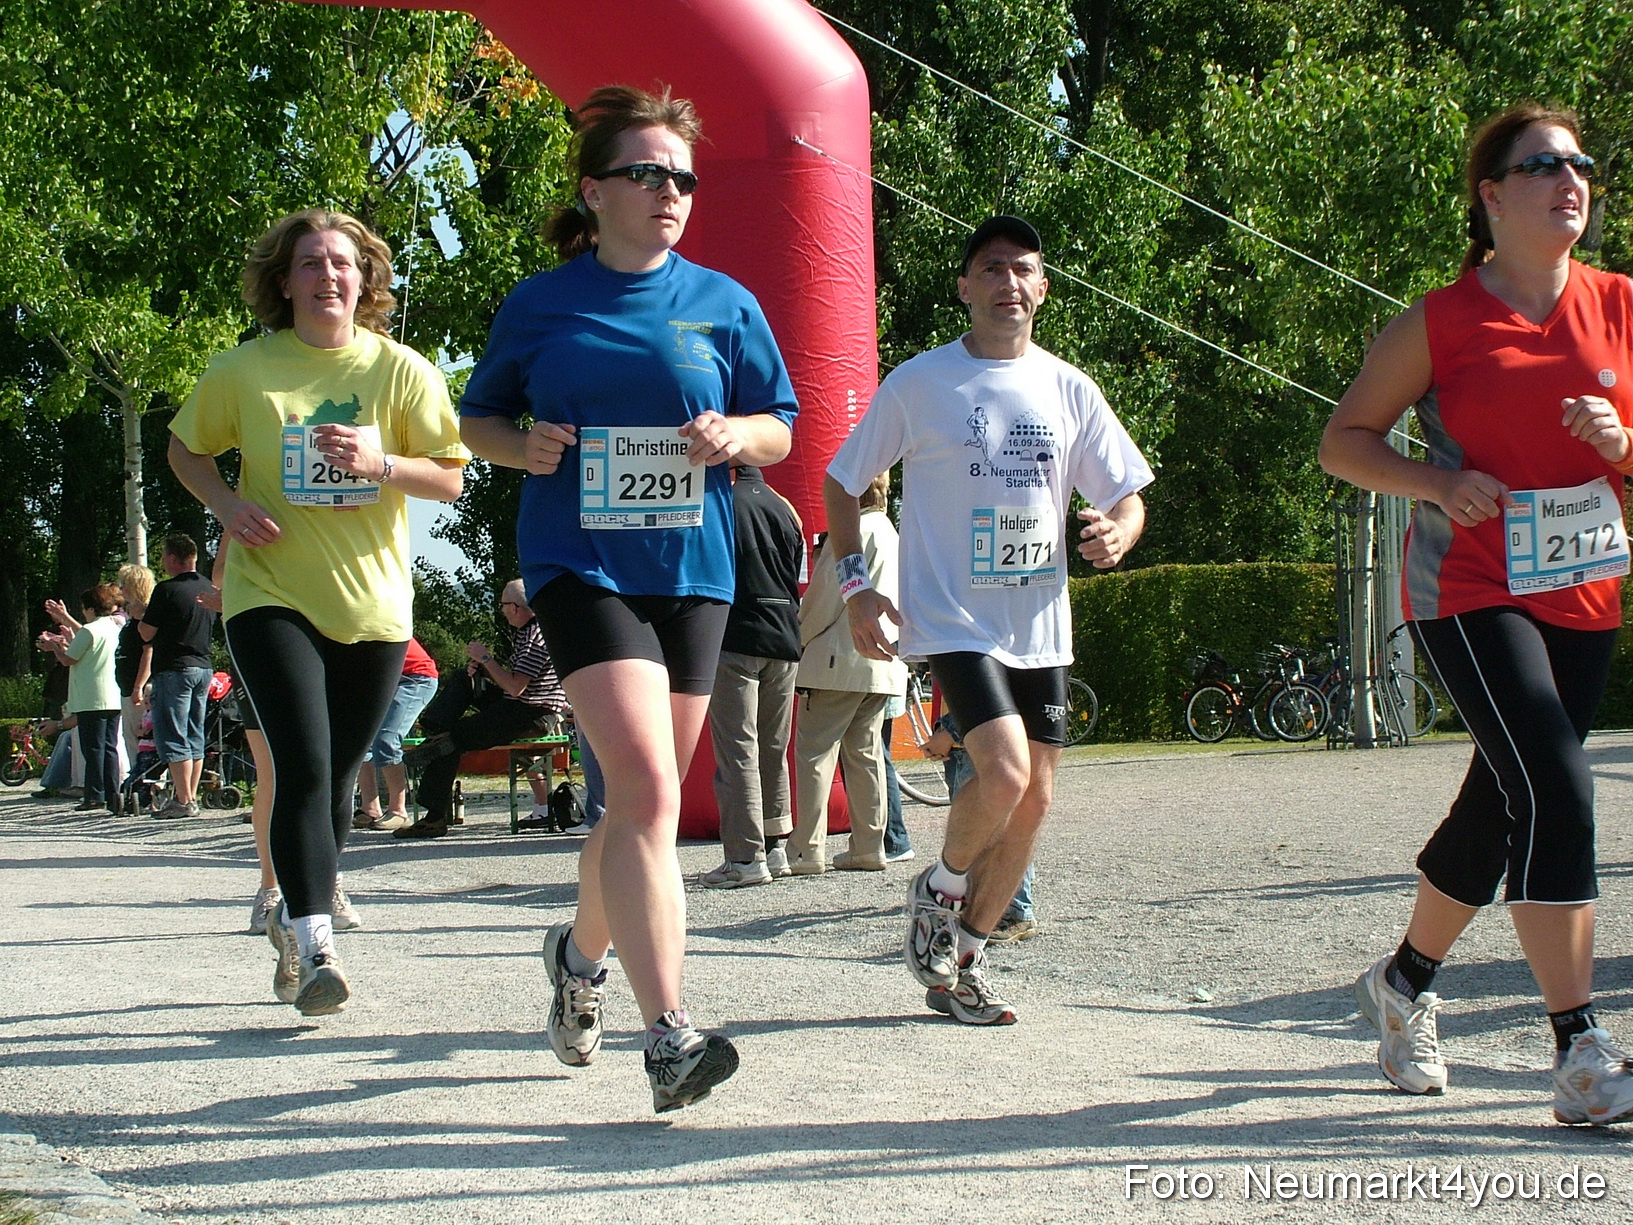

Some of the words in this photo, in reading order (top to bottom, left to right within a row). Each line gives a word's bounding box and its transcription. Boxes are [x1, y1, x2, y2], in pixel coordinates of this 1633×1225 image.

[847, 389, 857, 418] 1929
[616, 437, 689, 456] Christine
[1008, 439, 1055, 447] 16.09.2007
[311, 462, 373, 484] 264
[586, 467, 594, 481] D
[970, 463, 987, 477] 8.
[618, 472, 692, 500] 2291
[1542, 491, 1601, 519] Manuela
[581, 514, 629, 524] BOCK
[657, 512, 701, 522] PFLEIDERER
[1000, 514, 1039, 533] Holger
[1511, 532, 1520, 547] D
[1546, 522, 1620, 563] 2172
[1001, 541, 1051, 566] 2171
[1585, 562, 1628, 577] PFLEIDERER
[1510, 576, 1558, 590] BOCK
